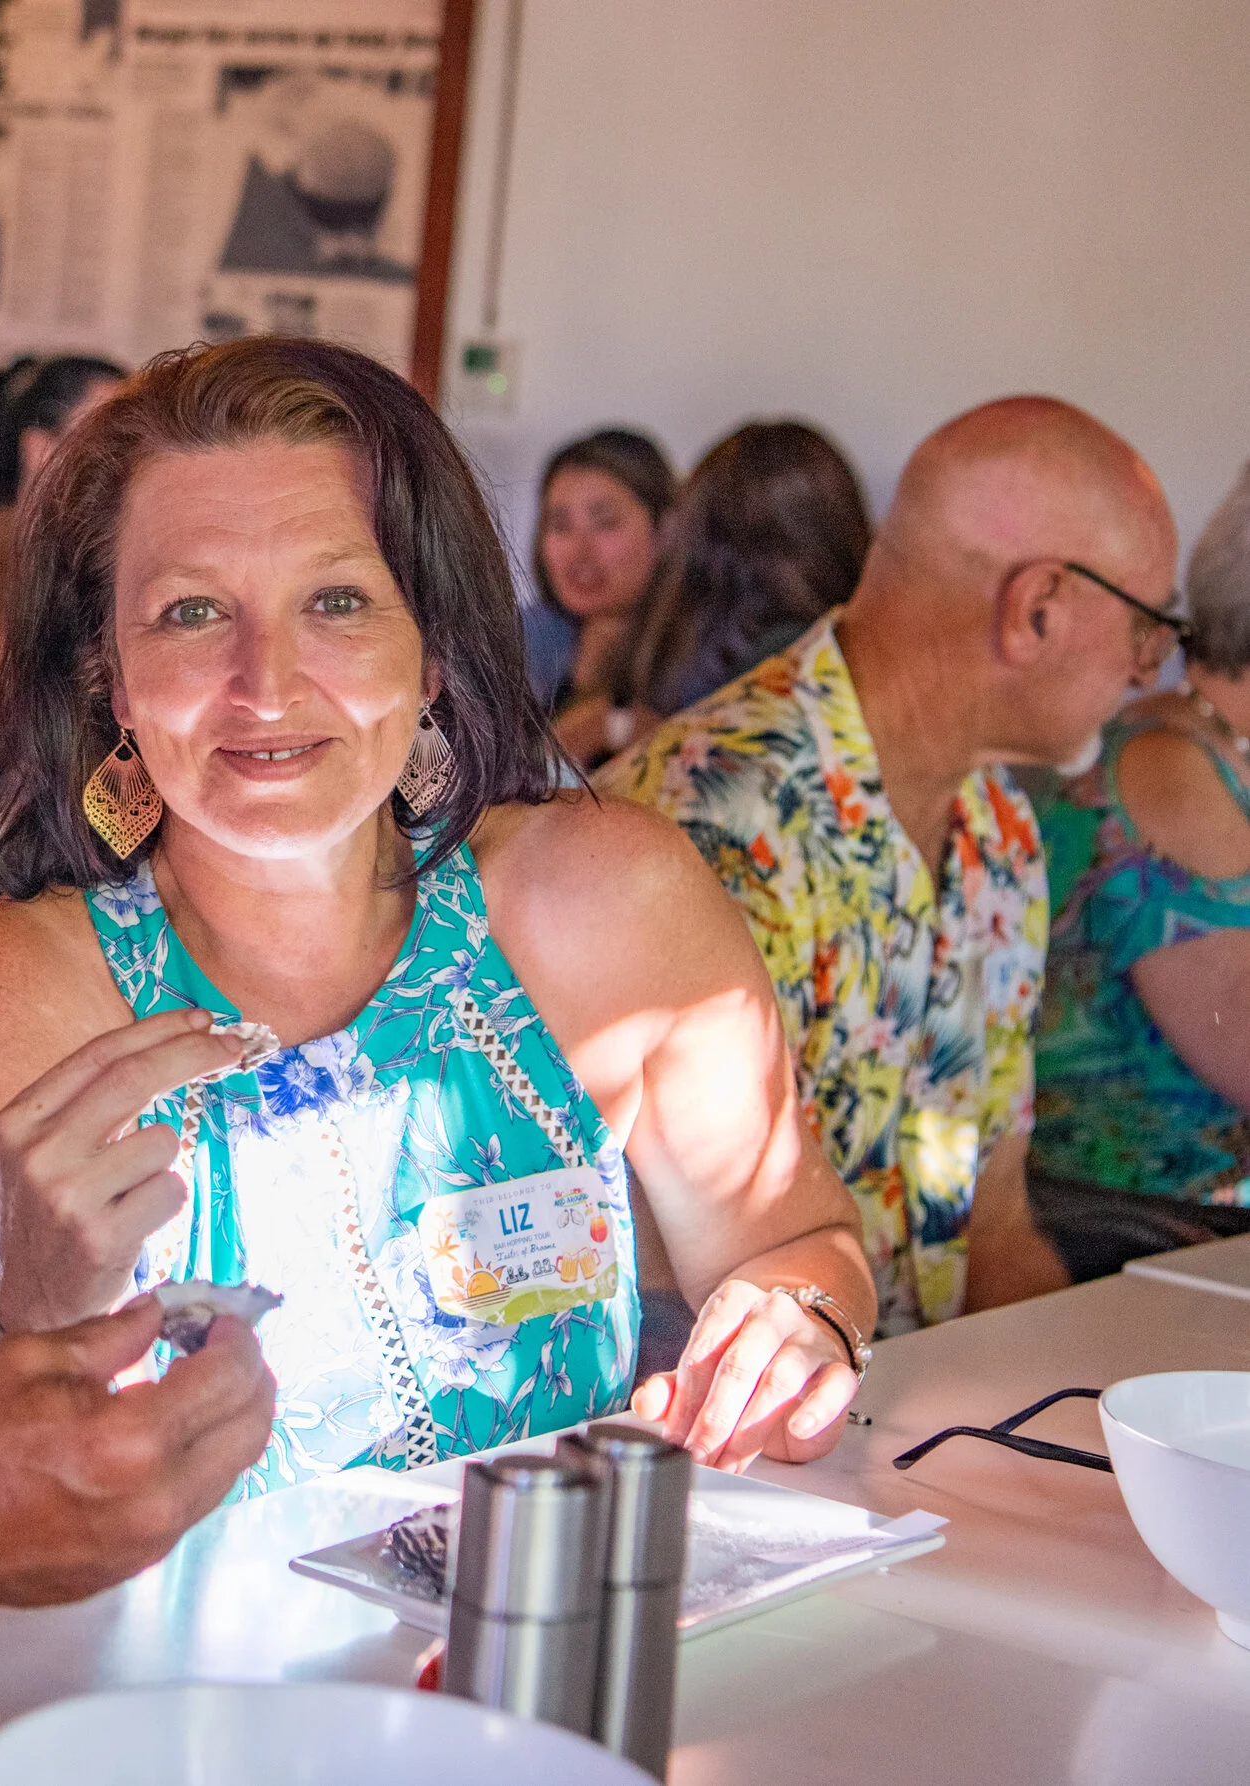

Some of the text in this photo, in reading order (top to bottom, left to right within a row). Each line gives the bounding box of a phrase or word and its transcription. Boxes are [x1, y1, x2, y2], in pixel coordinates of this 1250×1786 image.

[499, 1202, 534, 1236] LIZ
[506, 1235, 533, 1246] HOPPING
[534, 1231, 551, 1240] TOUR
[530, 1243, 556, 1253] Broome
